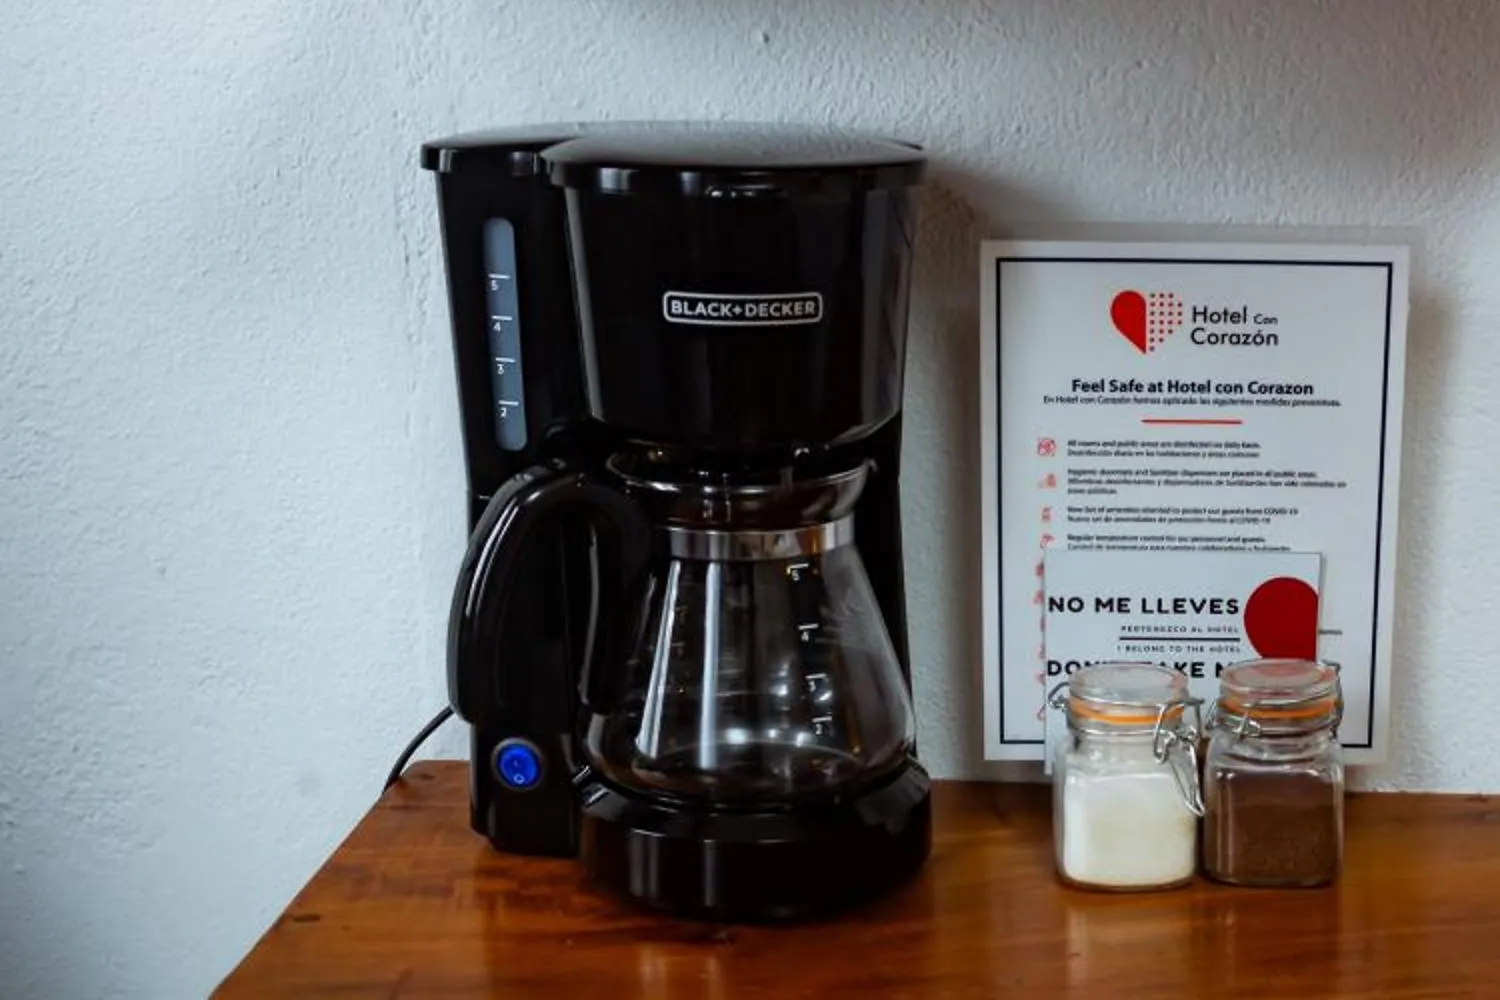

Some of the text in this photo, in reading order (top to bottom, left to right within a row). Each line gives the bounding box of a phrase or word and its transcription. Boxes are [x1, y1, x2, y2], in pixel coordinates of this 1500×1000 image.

[670, 299, 816, 318] BLACK+DECKER
[1192, 304, 1279, 326] Hotel Con
[1190, 326, 1279, 347] Corazón
[1071, 378, 1314, 395] Feel Safe at Hotel con Corazon
[1048, 597, 1239, 615] NO ME LLEVES
